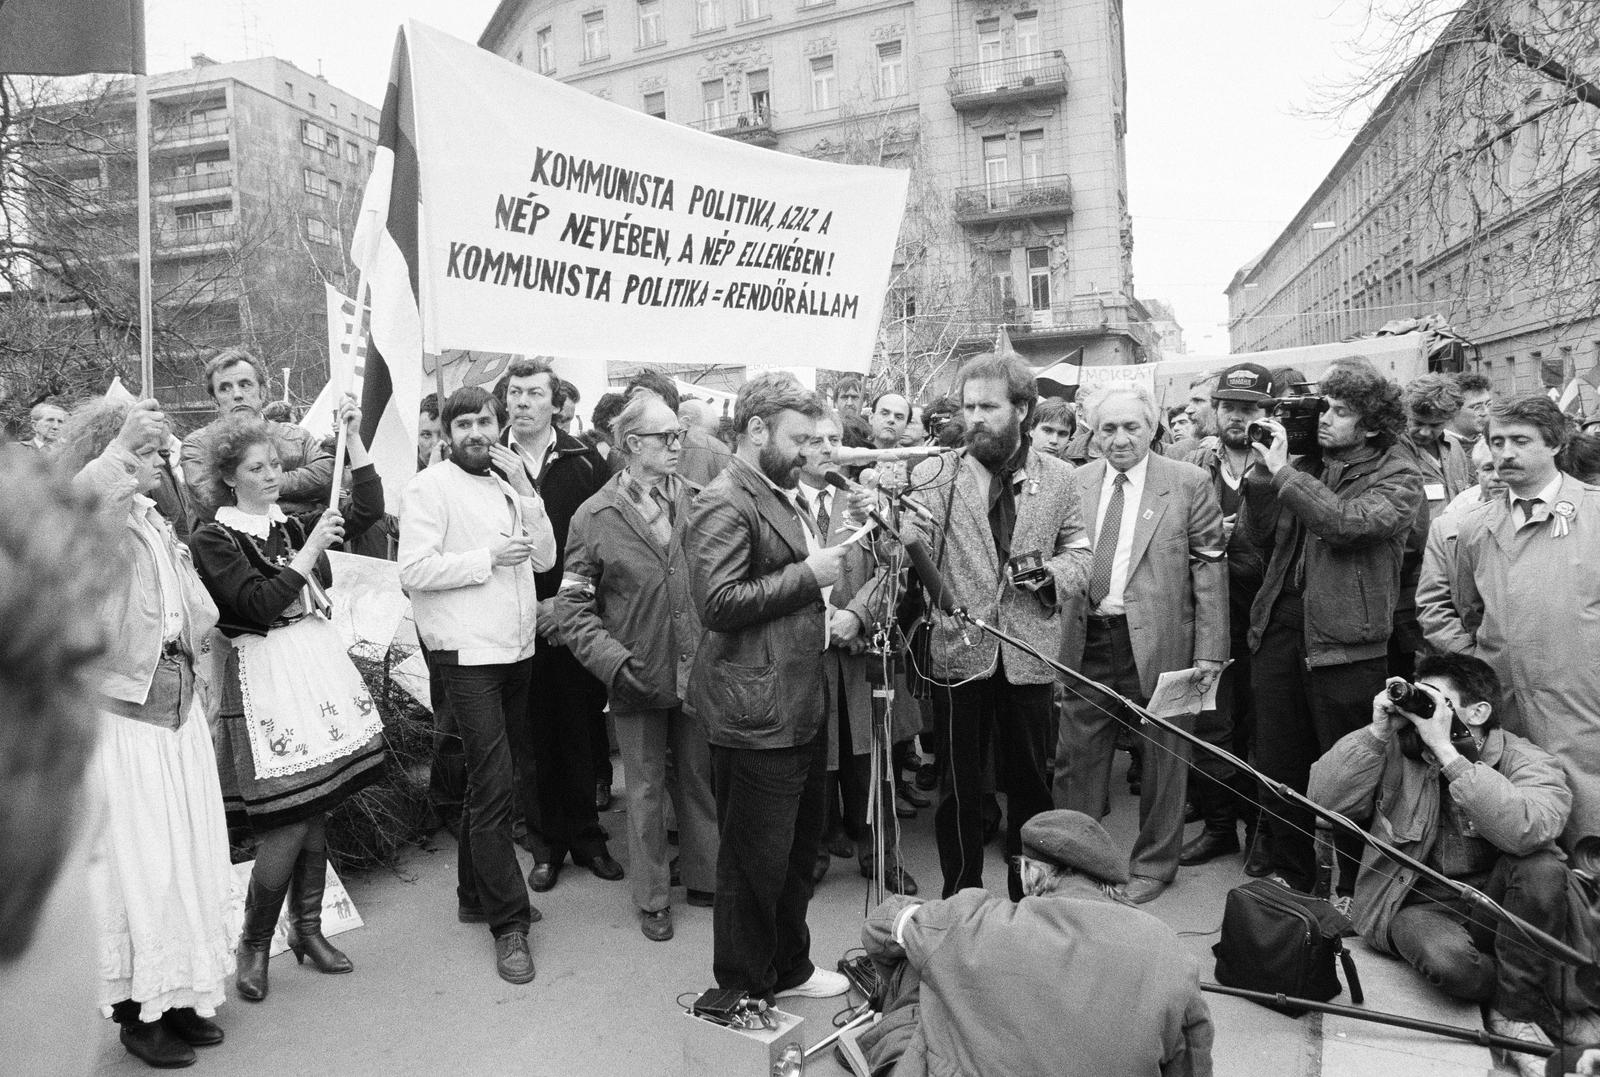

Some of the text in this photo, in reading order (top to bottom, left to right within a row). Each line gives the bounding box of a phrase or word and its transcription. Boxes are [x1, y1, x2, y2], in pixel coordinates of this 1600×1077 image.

[530, 147, 833, 235] KOMMUNISTA POLITIKA, AZAZ A
[495, 192, 550, 235] NÉP
[559, 213, 671, 266] NEVÉBEN,
[677, 233, 693, 264] A
[699, 230, 736, 266] NÉP
[446, 242, 612, 302] KOMMUNISTA
